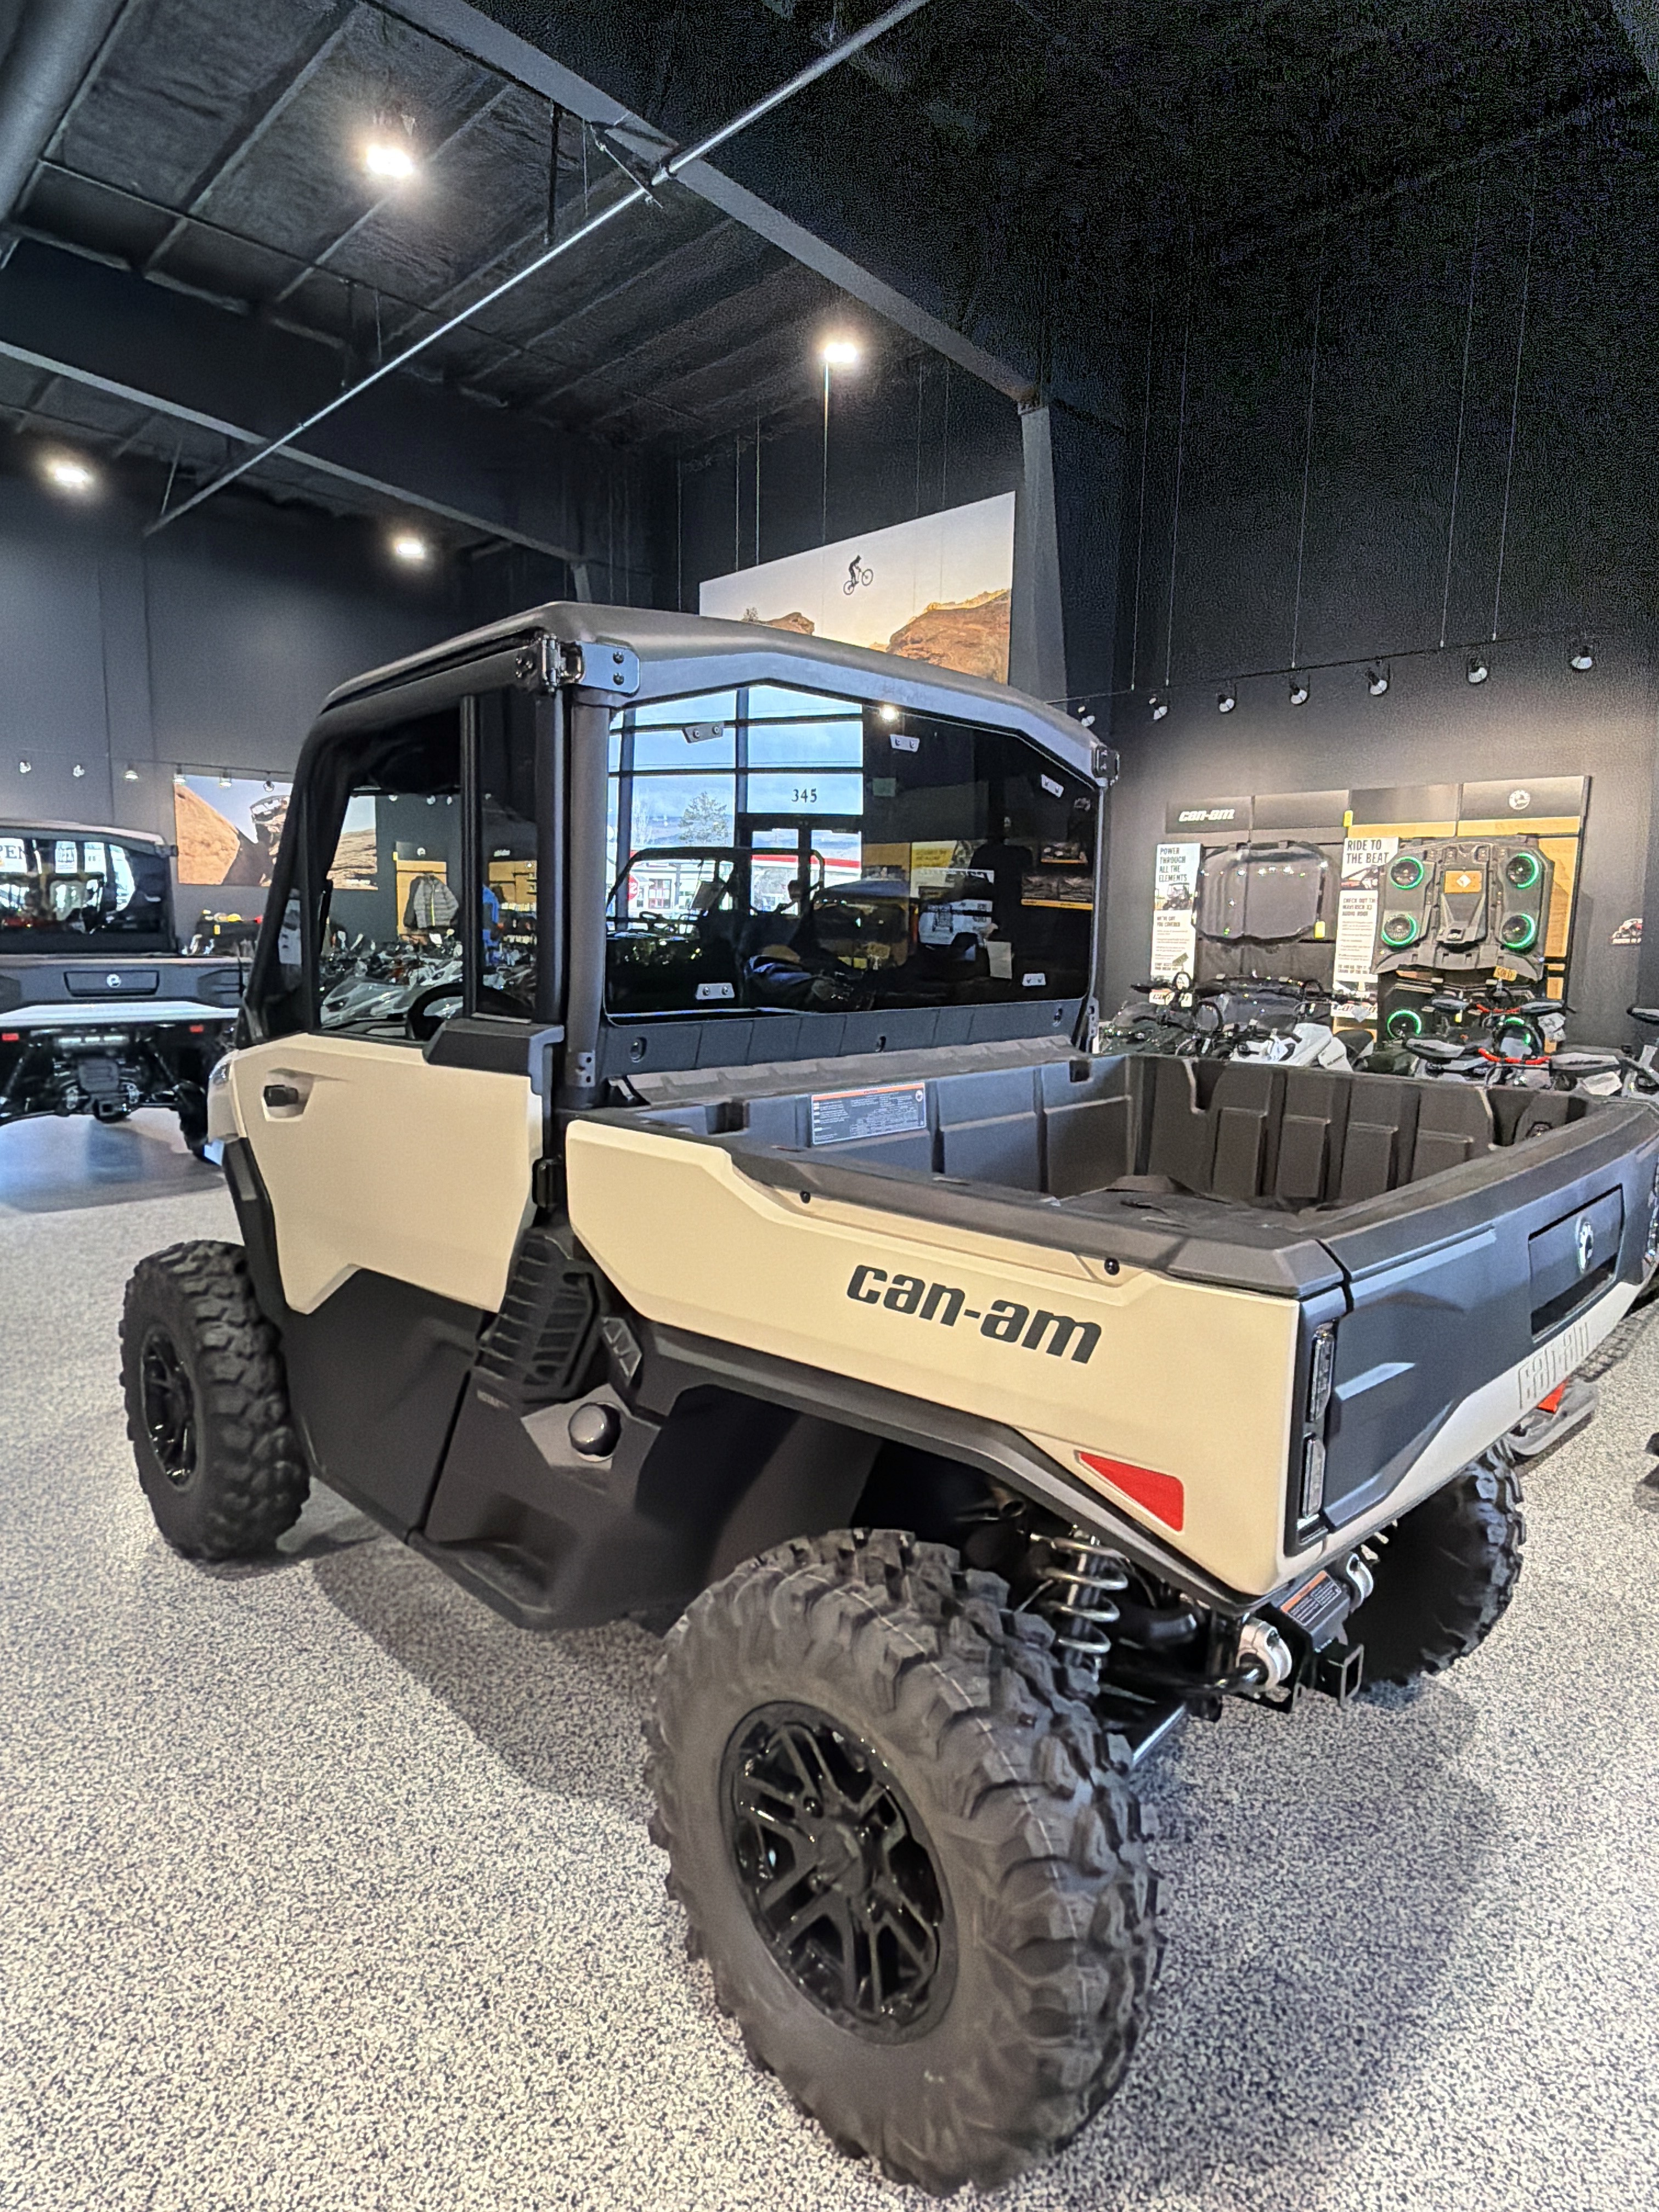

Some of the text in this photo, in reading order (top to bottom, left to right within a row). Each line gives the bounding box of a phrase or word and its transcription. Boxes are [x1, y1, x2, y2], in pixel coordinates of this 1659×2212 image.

[791, 788, 817, 803] 345
[1178, 809, 1235, 822] can-am
[1347, 839, 1381, 851] RIDE TO
[1160, 856, 1186, 864] THROUGH
[1346, 852, 1390, 864] THE BEAT
[1159, 874, 1187, 882] ELEMENTS
[847, 1265, 1102, 1364] can-am
